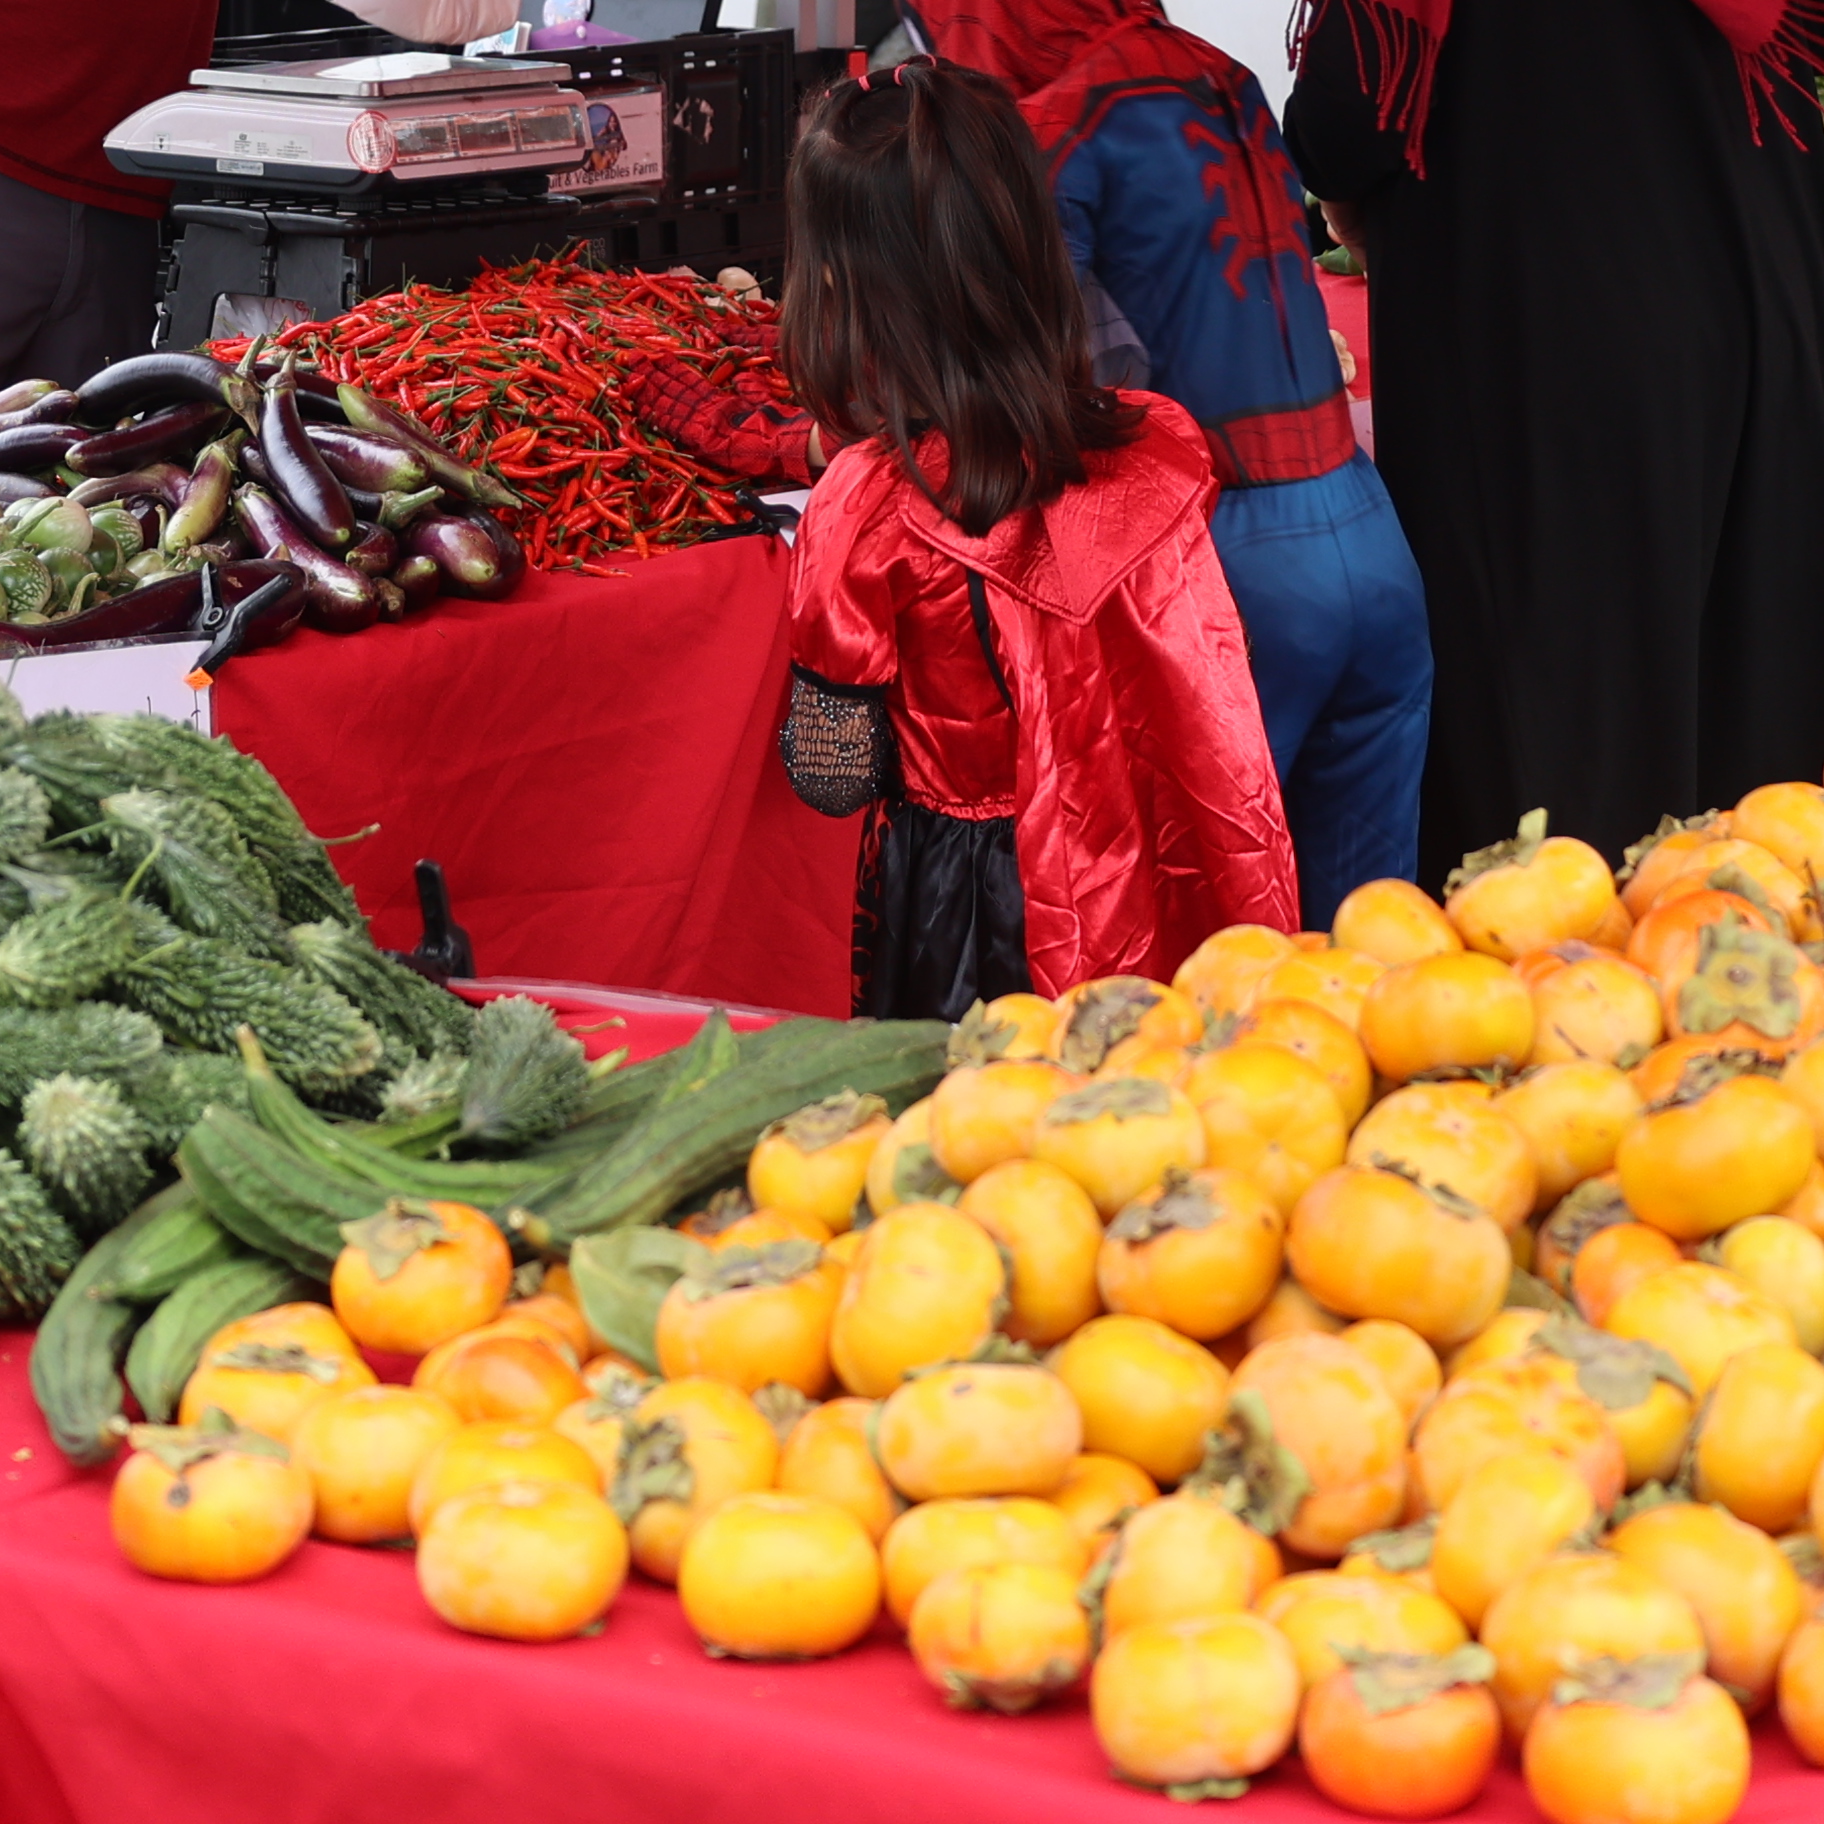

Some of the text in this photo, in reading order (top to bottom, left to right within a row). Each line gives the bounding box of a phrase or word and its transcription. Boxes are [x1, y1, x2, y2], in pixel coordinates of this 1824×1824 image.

[548, 174, 562, 190] uit
[577, 165, 631, 185] Vegetables
[633, 161, 659, 176] Farm
